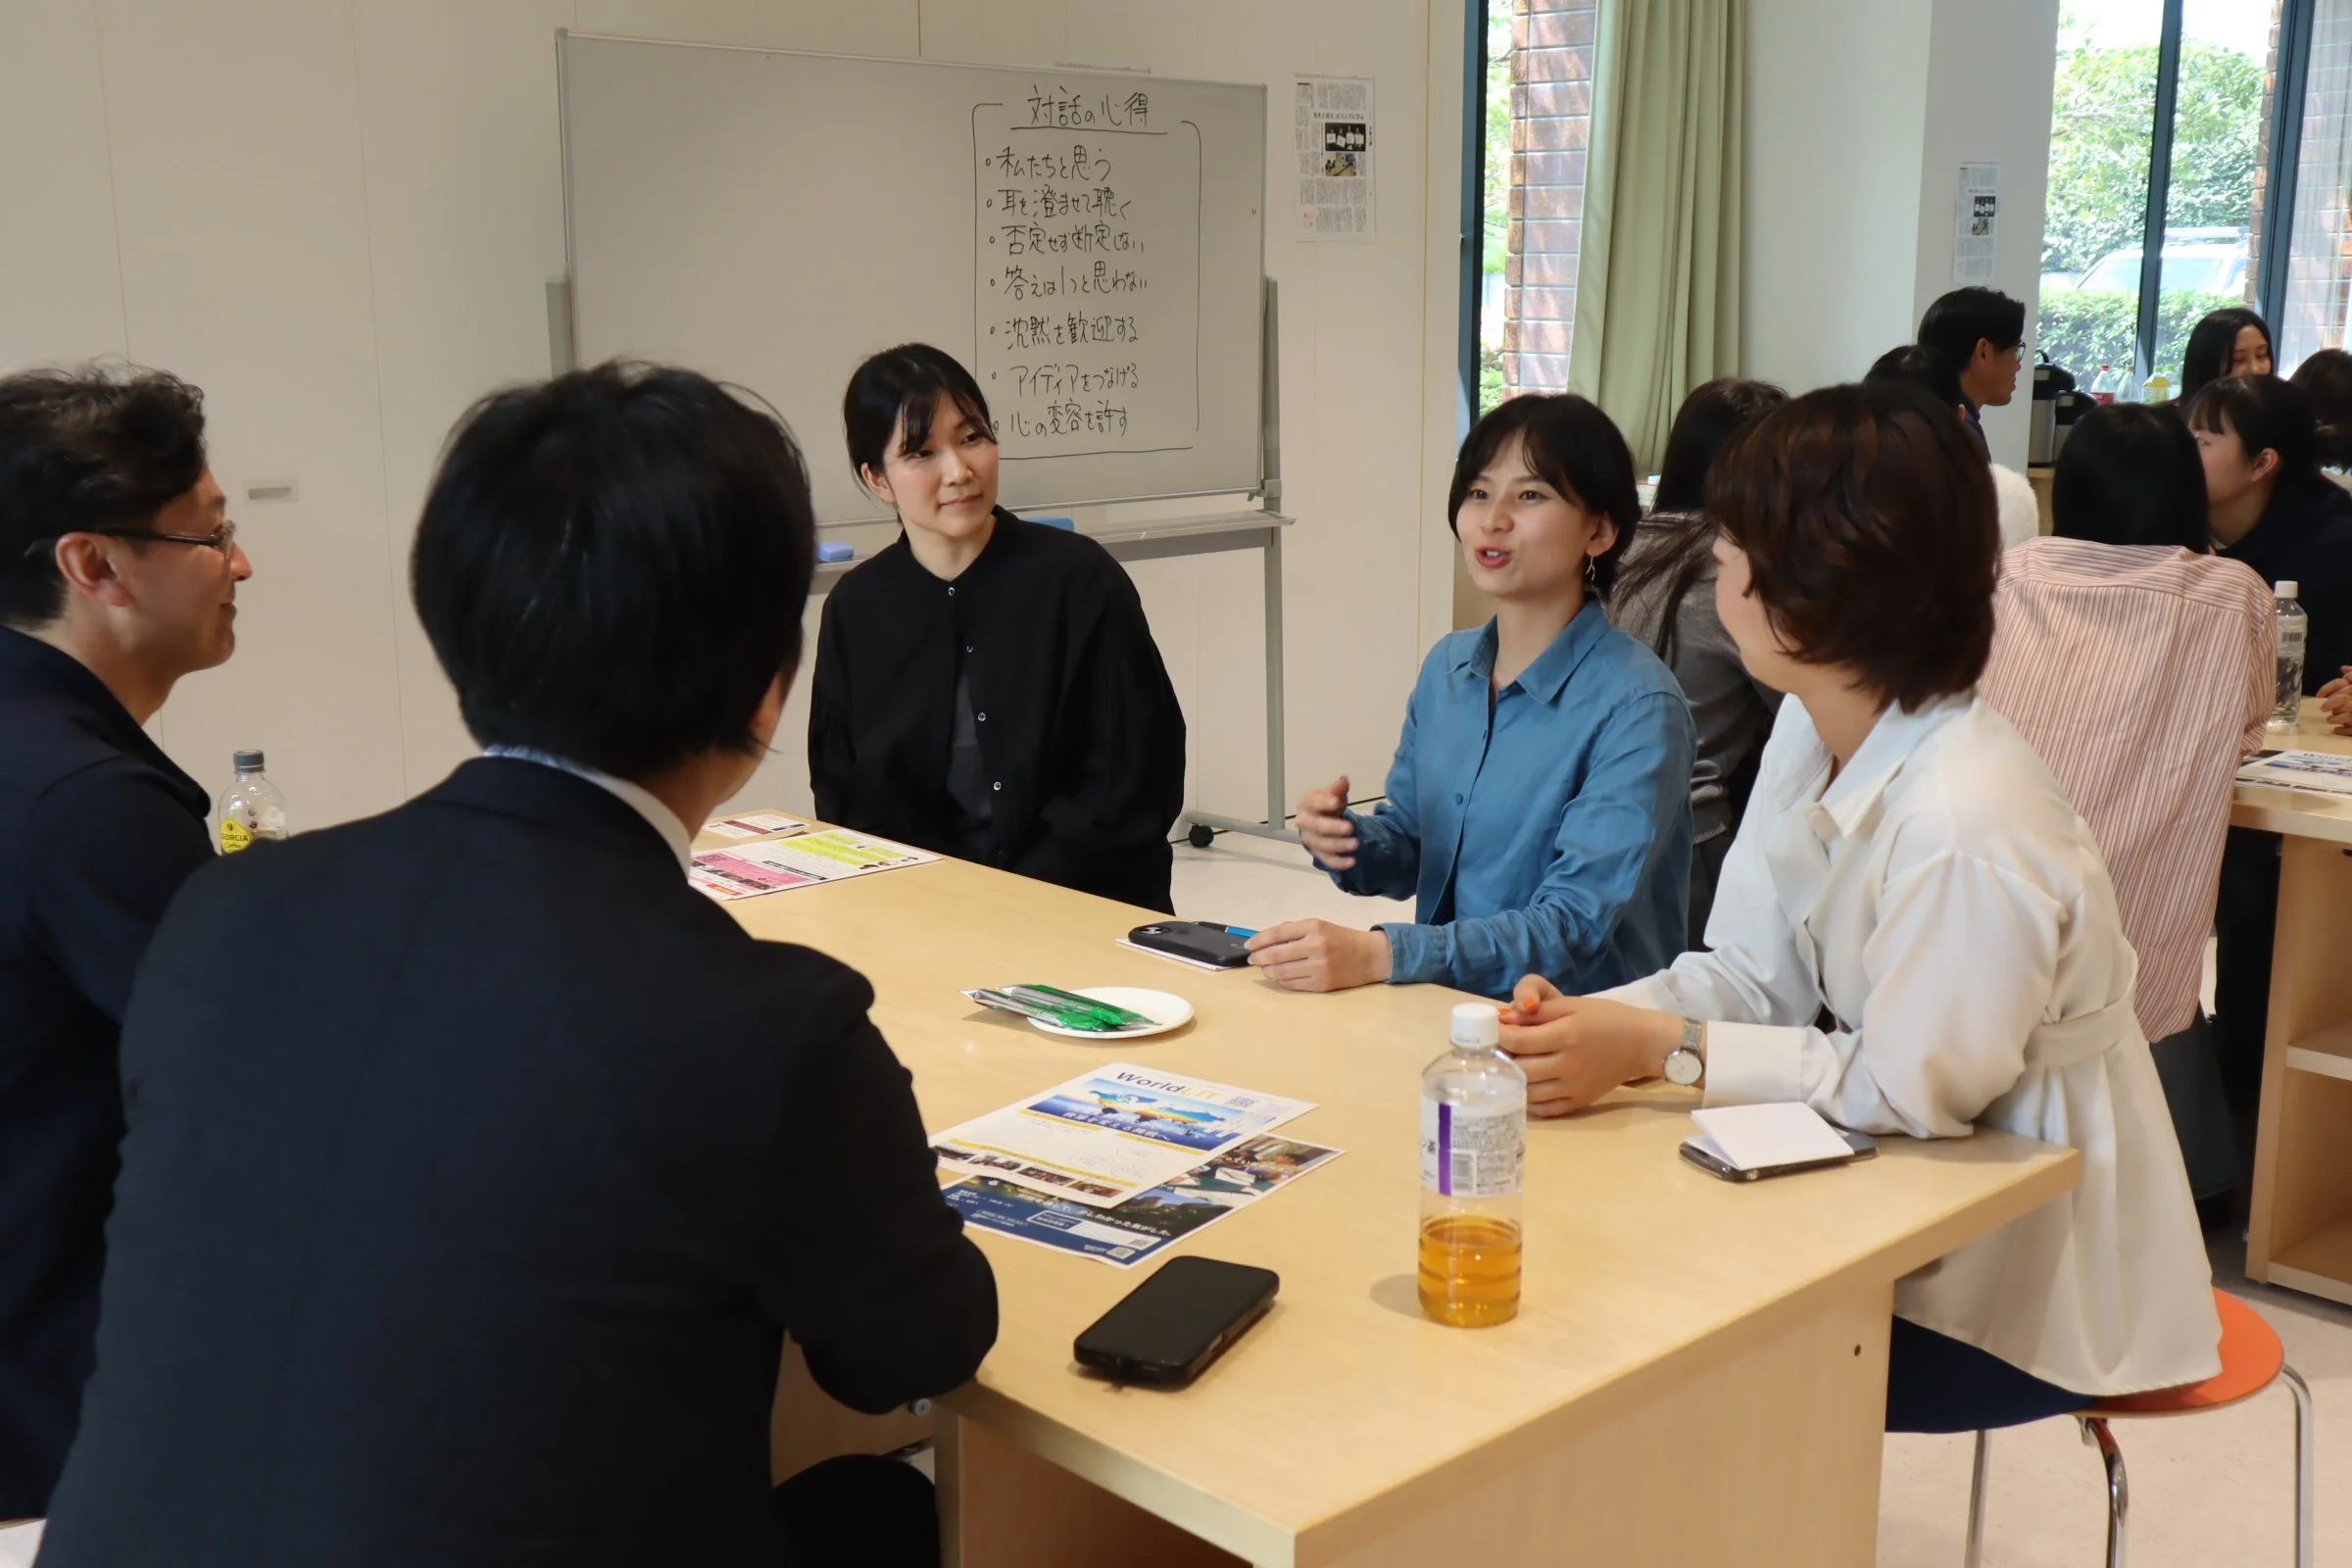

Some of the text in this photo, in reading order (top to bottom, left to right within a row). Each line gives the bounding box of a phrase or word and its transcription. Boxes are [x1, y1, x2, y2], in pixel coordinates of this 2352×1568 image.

[1027, 85, 1149, 126] 対話の心得
[996, 145, 1111, 181] 私たちと思う
[997, 184, 1132, 220] 耳を澄ませて聴く
[1004, 310, 1140, 350] 沈黙を歓迎する
[1009, 363, 1140, 397] アイディアをつなげる
[1010, 398, 1128, 437] 心の変容を許す
